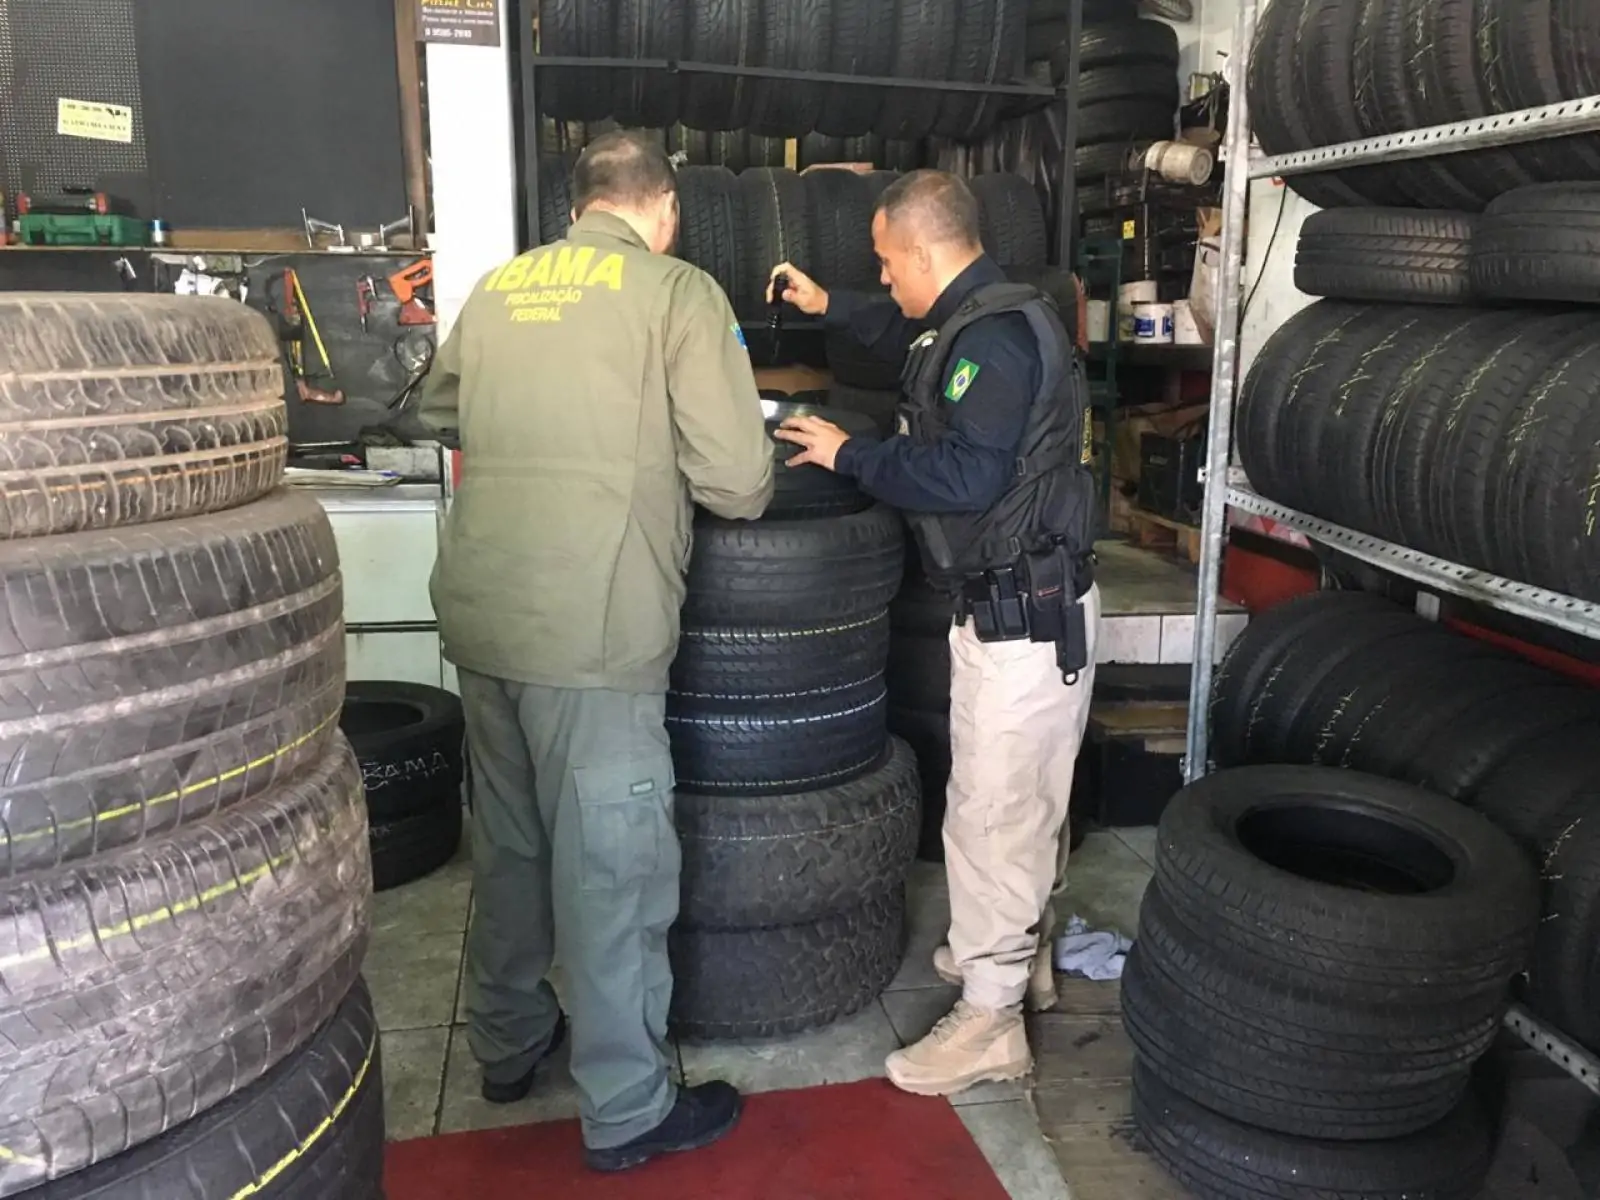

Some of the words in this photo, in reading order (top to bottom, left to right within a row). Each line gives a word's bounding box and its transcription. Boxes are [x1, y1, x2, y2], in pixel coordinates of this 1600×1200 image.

[484, 246, 624, 291] IBAMA
[510, 305, 561, 322] FEDERAL
[361, 751, 449, 790] BAMA
